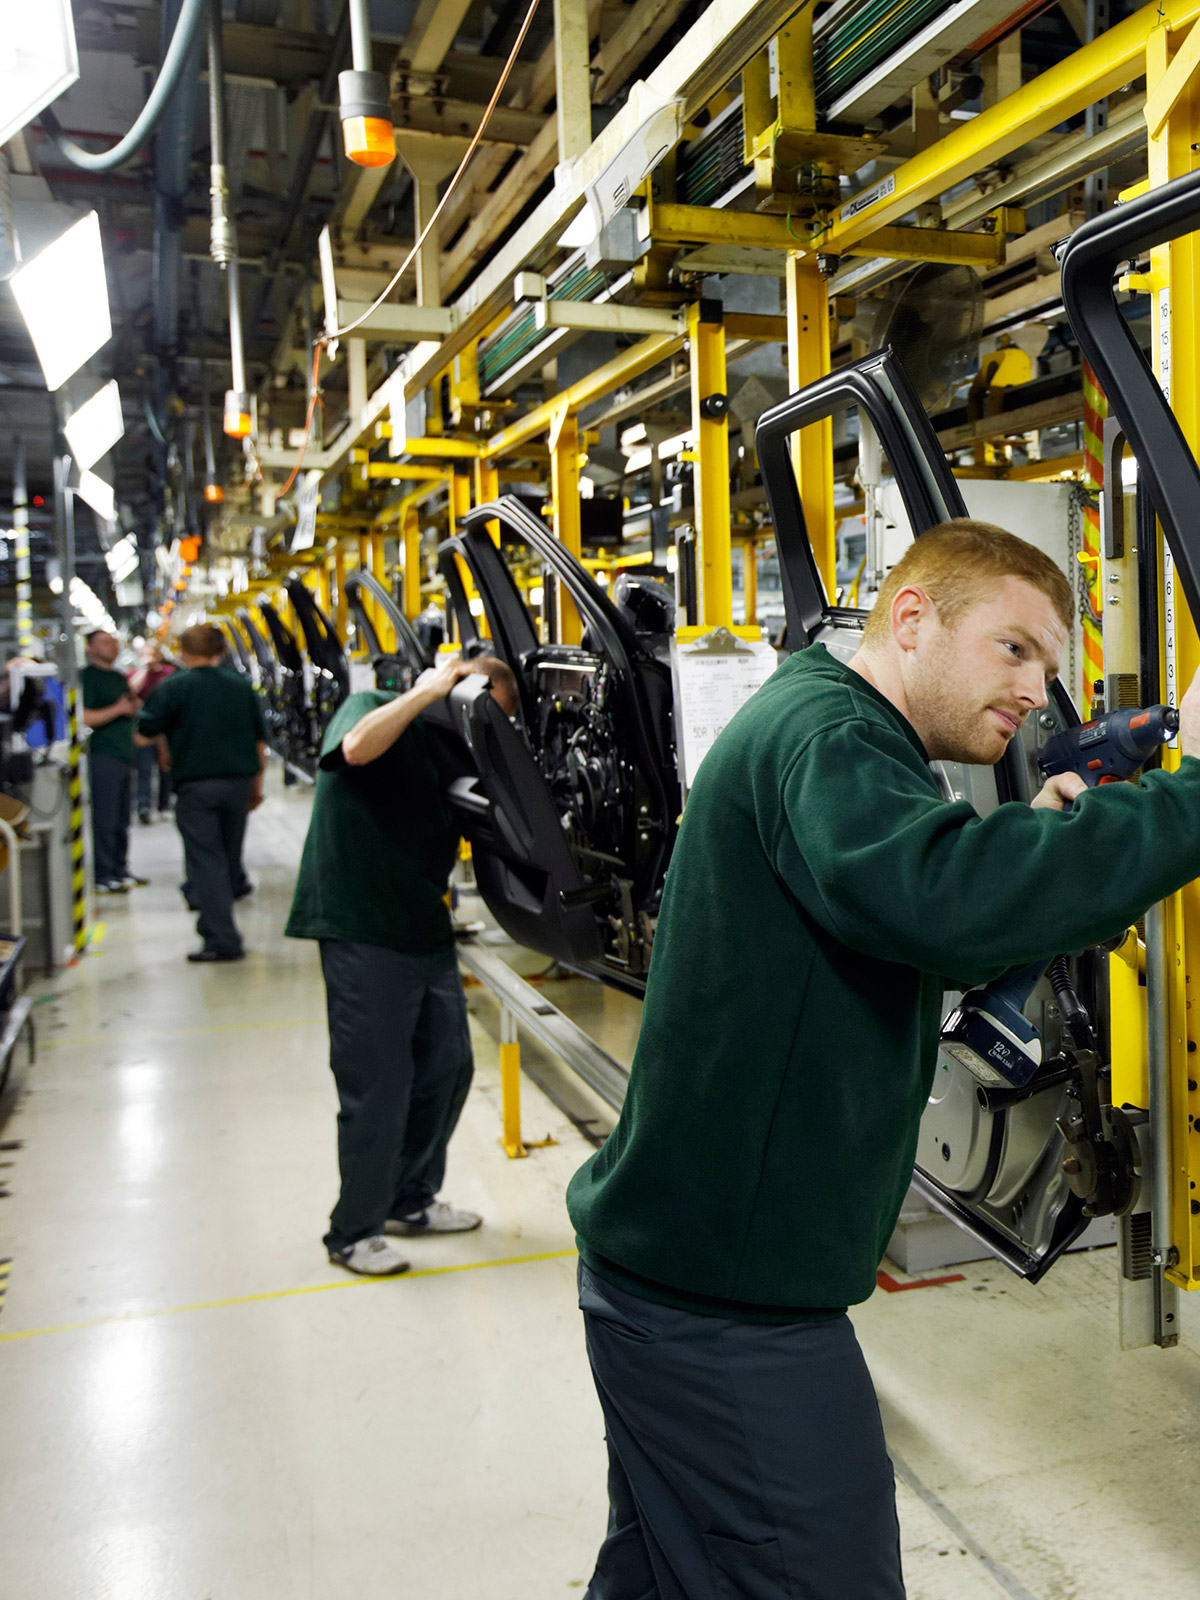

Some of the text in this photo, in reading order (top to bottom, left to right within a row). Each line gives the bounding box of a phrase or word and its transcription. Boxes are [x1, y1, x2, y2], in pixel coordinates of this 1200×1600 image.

[1166, 554, 1171, 567] 7
[1166, 581, 1172, 595] 6
[1167, 609, 1172, 623] 5
[1168, 637, 1173, 650] 4
[1168, 664, 1174, 678] 3
[1169, 691, 1174, 705] 2
